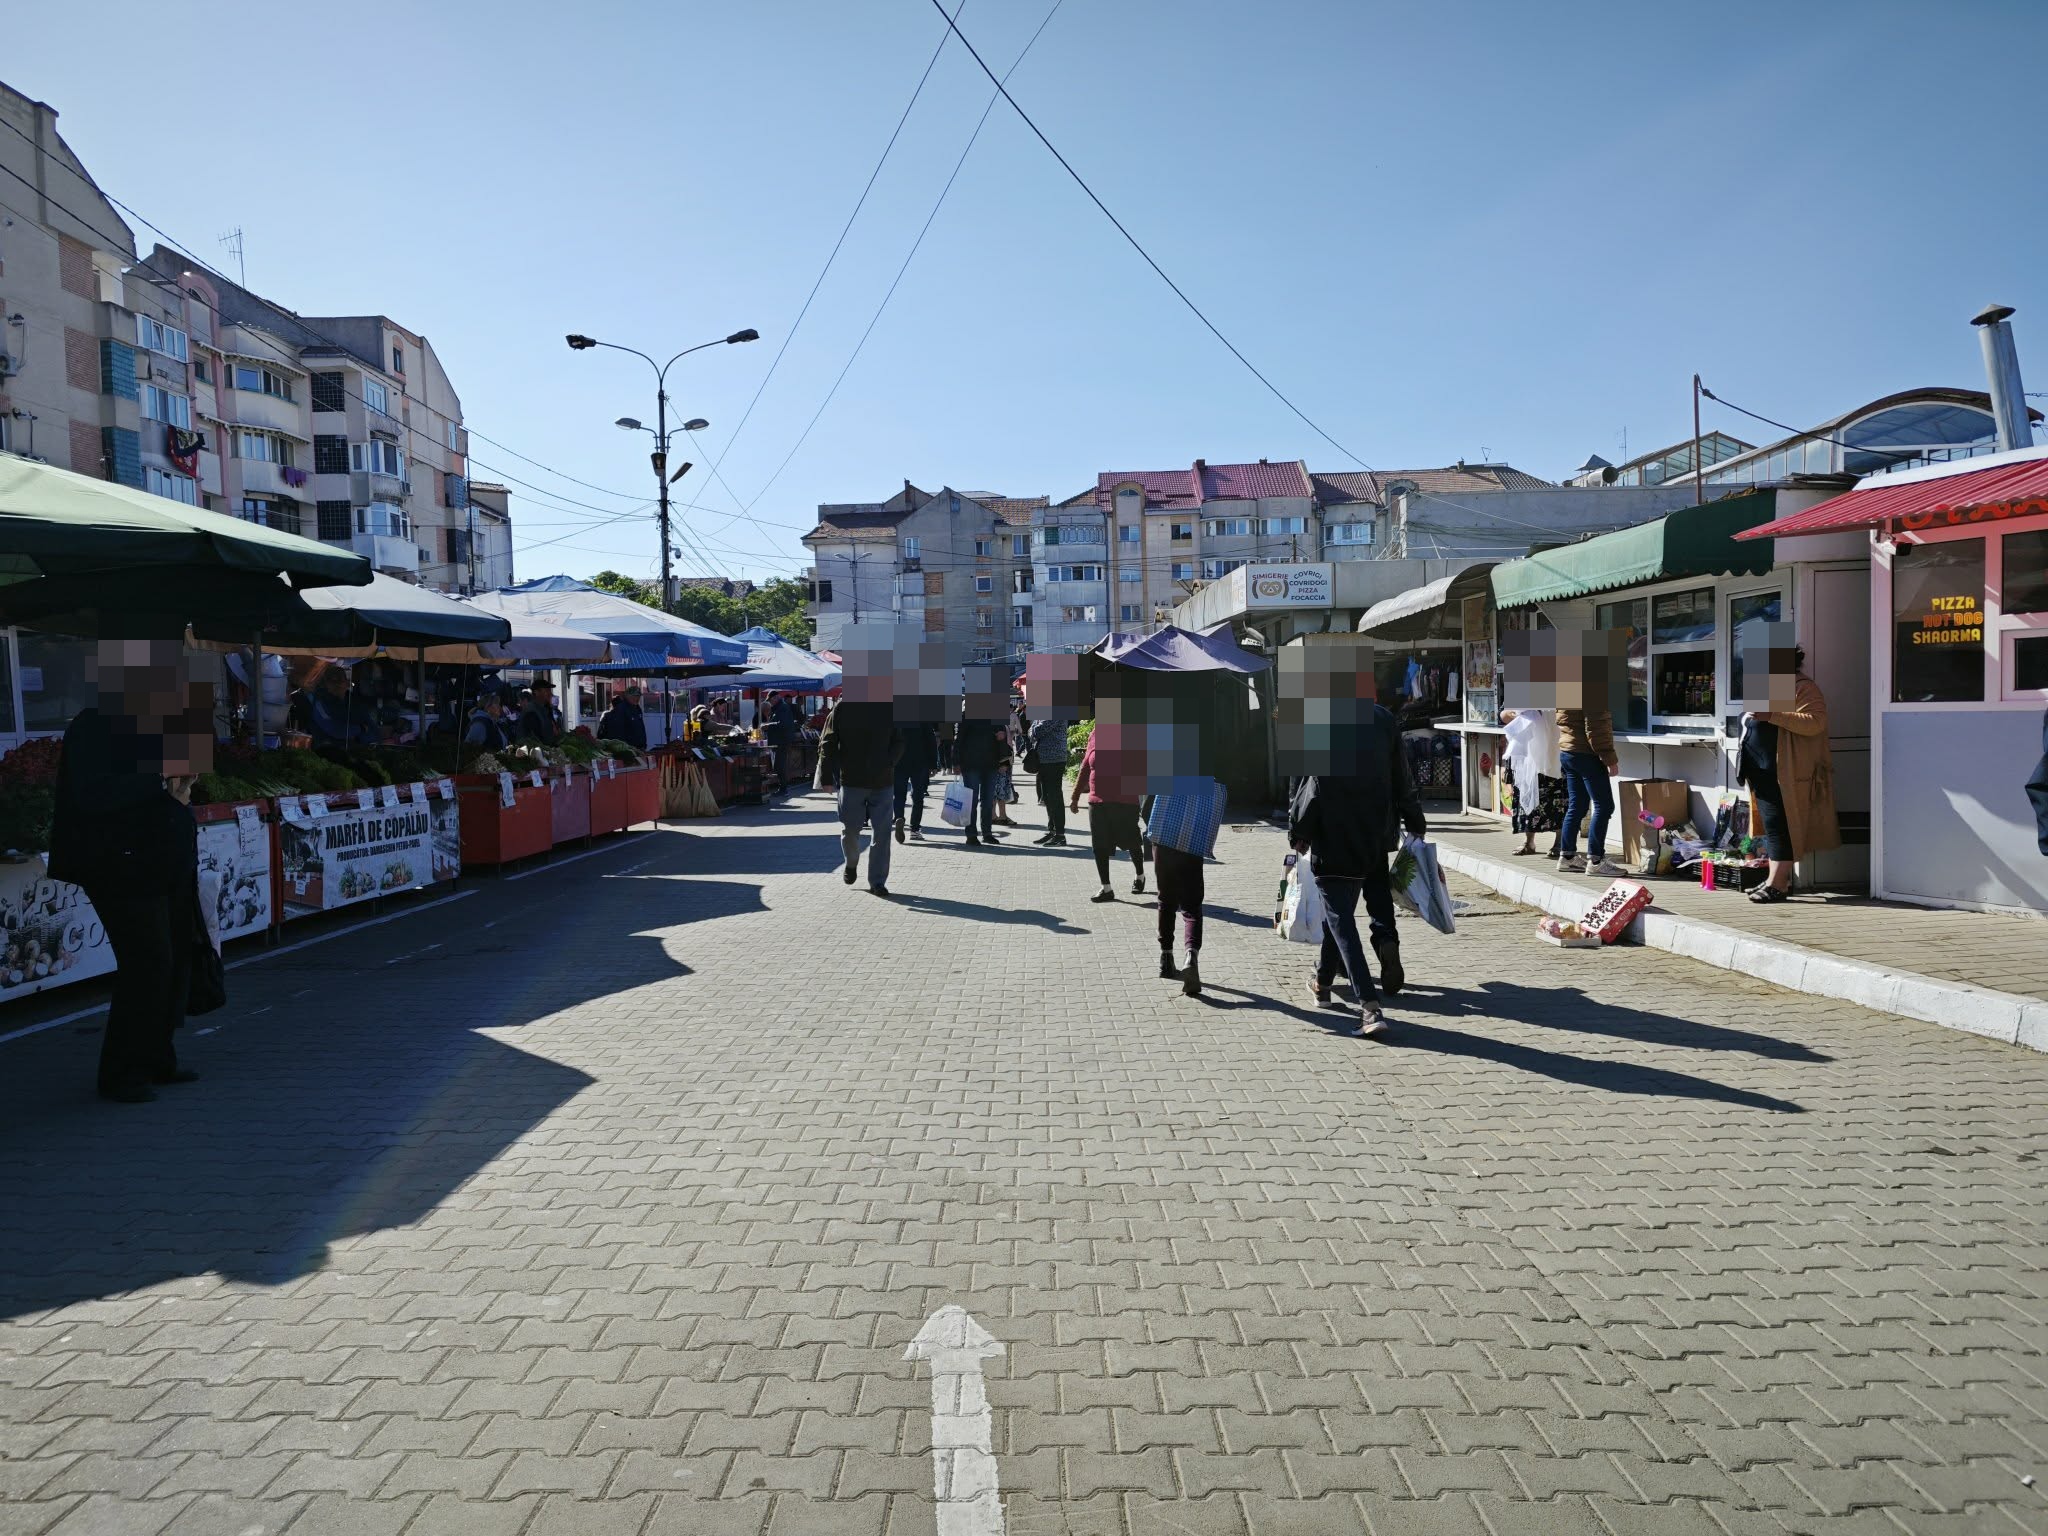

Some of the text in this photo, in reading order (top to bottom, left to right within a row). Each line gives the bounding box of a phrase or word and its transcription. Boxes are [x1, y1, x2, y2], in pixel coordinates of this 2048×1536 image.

[1252, 573, 1289, 581] SIMIGERIE
[1293, 570, 1323, 580] COVRIGI
[1931, 596, 1975, 611] PIZZA
[1923, 611, 1984, 628] HOT DOG
[1912, 628, 1981, 645] SHAORMA
[325, 810, 428, 850] MARFĂ DE COPĂLĂU
